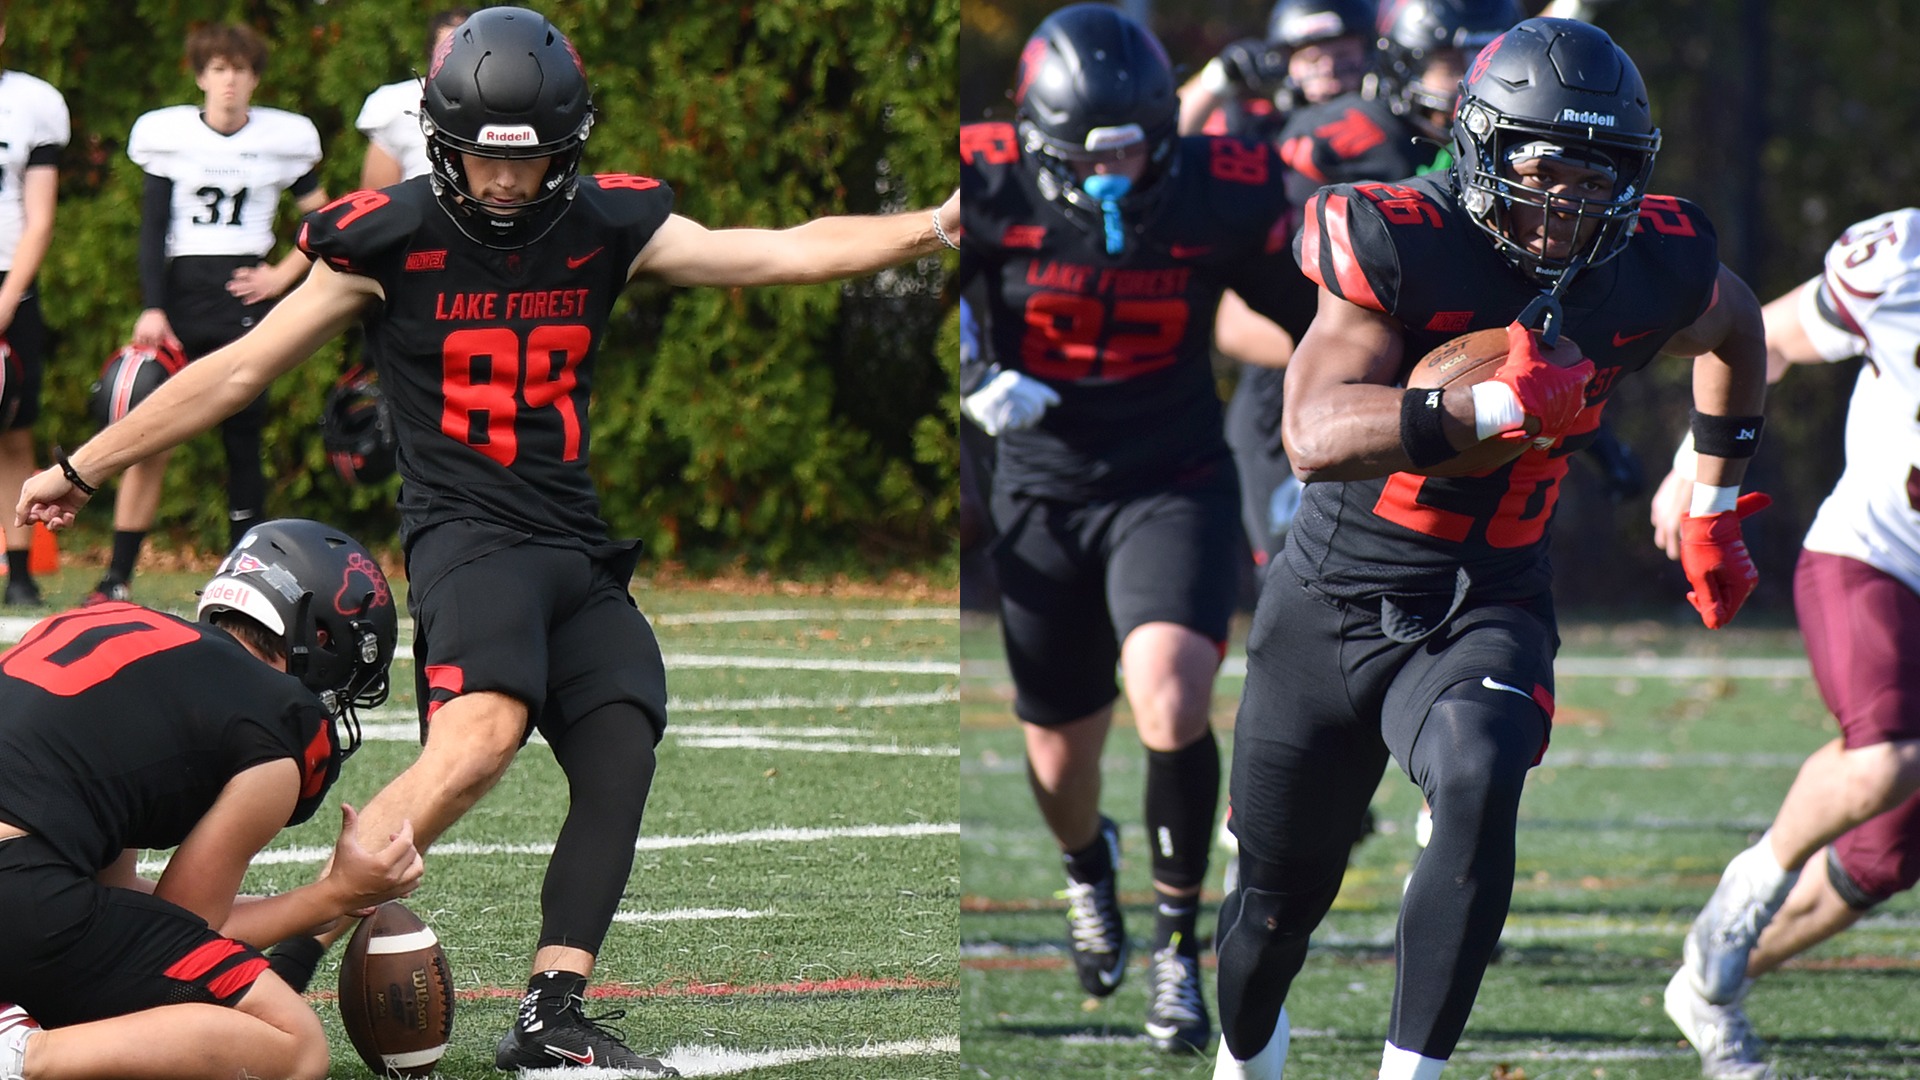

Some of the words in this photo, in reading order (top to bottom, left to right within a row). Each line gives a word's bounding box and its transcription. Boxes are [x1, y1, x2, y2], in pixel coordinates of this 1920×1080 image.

[1563, 108, 1615, 127] Riddell
[486, 131, 530, 142] Riddell
[192, 186, 248, 226] 31
[1352, 183, 1444, 229] 26
[491, 219, 515, 228] Riddell
[1535, 266, 1563, 277] Riddell
[435, 292, 498, 320] LAKE
[506, 289, 589, 320] FOREST
[1021, 291, 1190, 383] 82
[1428, 339, 1472, 368] GST
[1440, 353, 1468, 373] NCAA
[441, 325, 592, 468] 89
[205, 583, 250, 607] ddell
[411, 968, 428, 1030] Wilson
